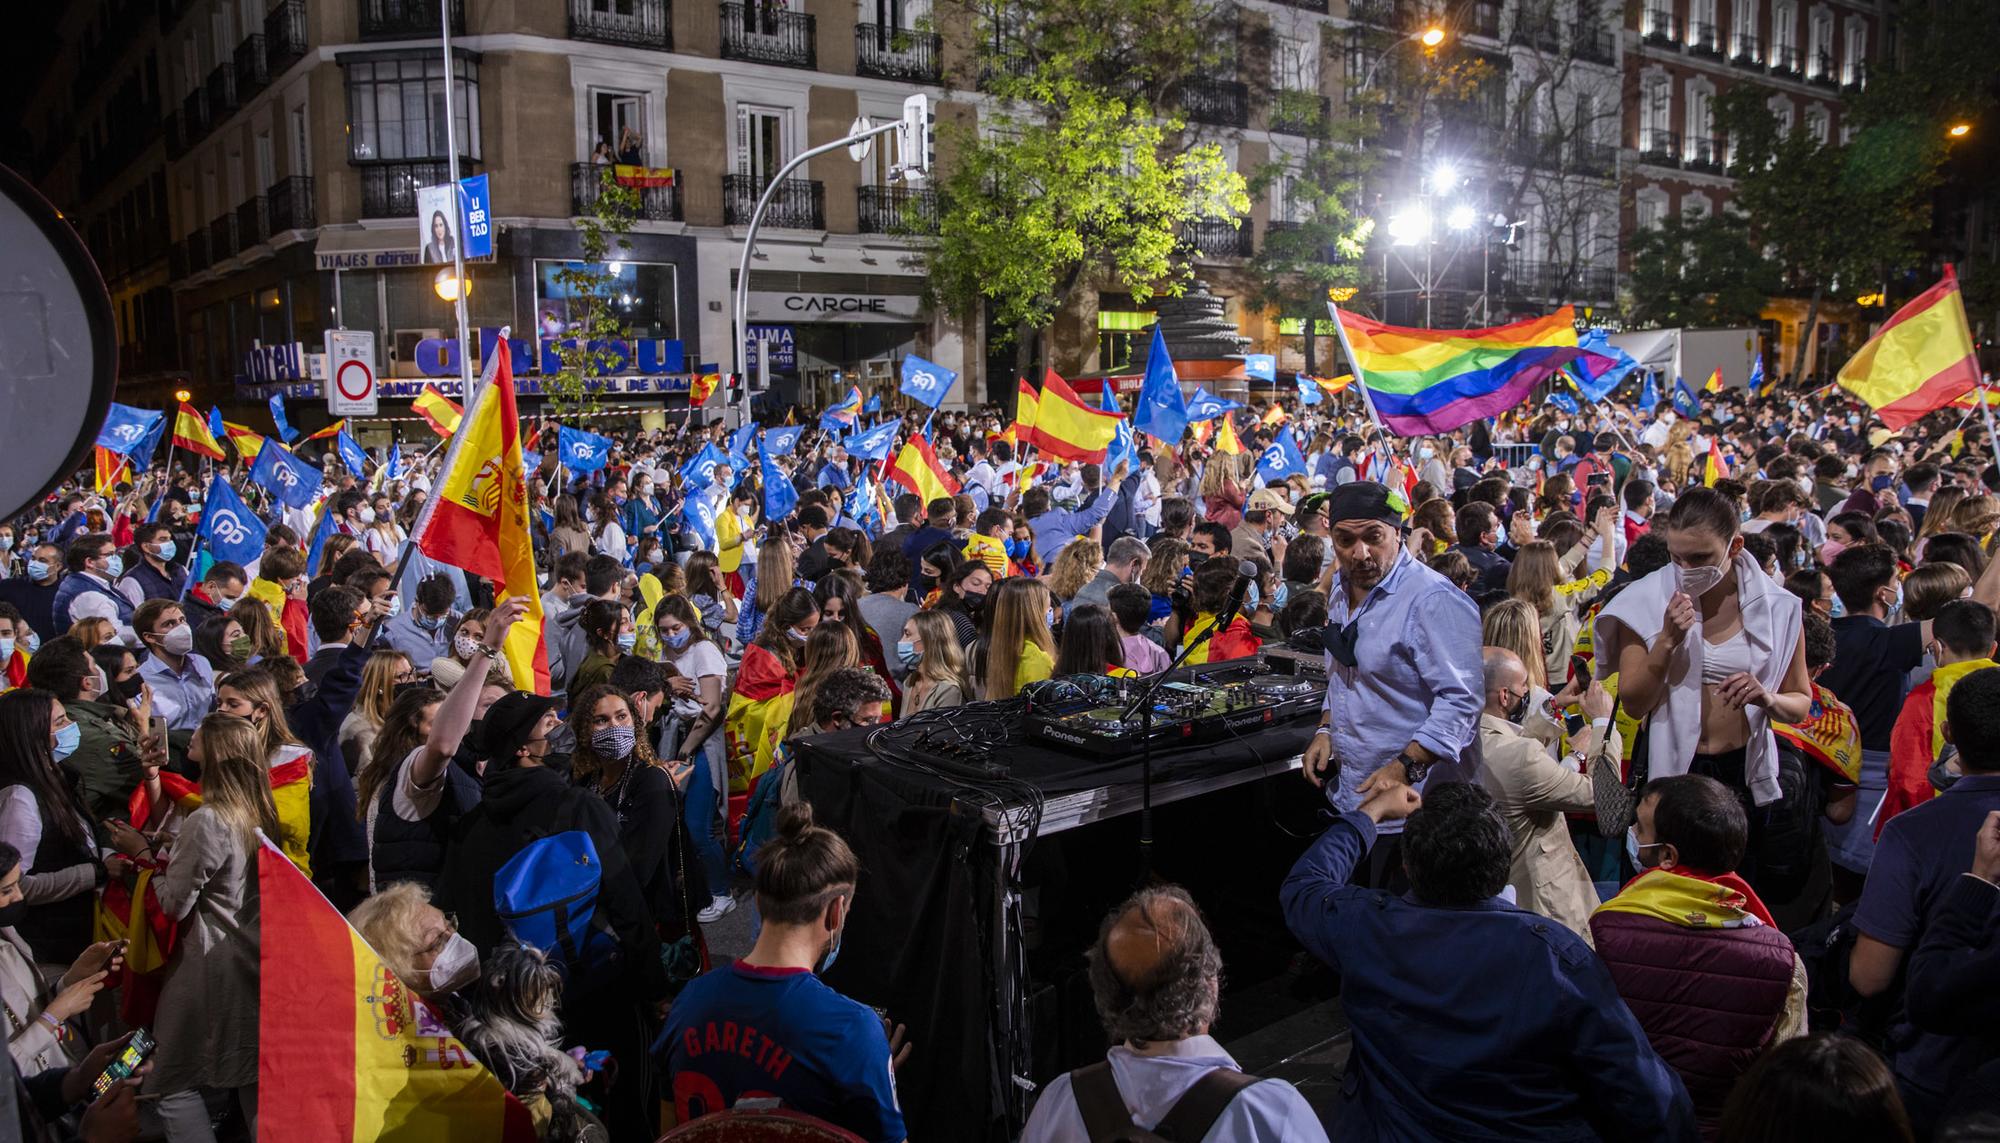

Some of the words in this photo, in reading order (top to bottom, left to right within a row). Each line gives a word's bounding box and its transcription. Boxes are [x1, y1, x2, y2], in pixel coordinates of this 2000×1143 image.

[469, 209, 486, 224] BER
[469, 222, 488, 238] TAD
[320, 253, 369, 268] VIAJES
[375, 251, 419, 265] abreu
[784, 296, 887, 313] CARCHE
[627, 378, 649, 391] DE
[1225, 714, 1264, 731] Pioneer
[1042, 726, 1087, 745] Pioneer
[683, 1021, 793, 1080] GARETH
